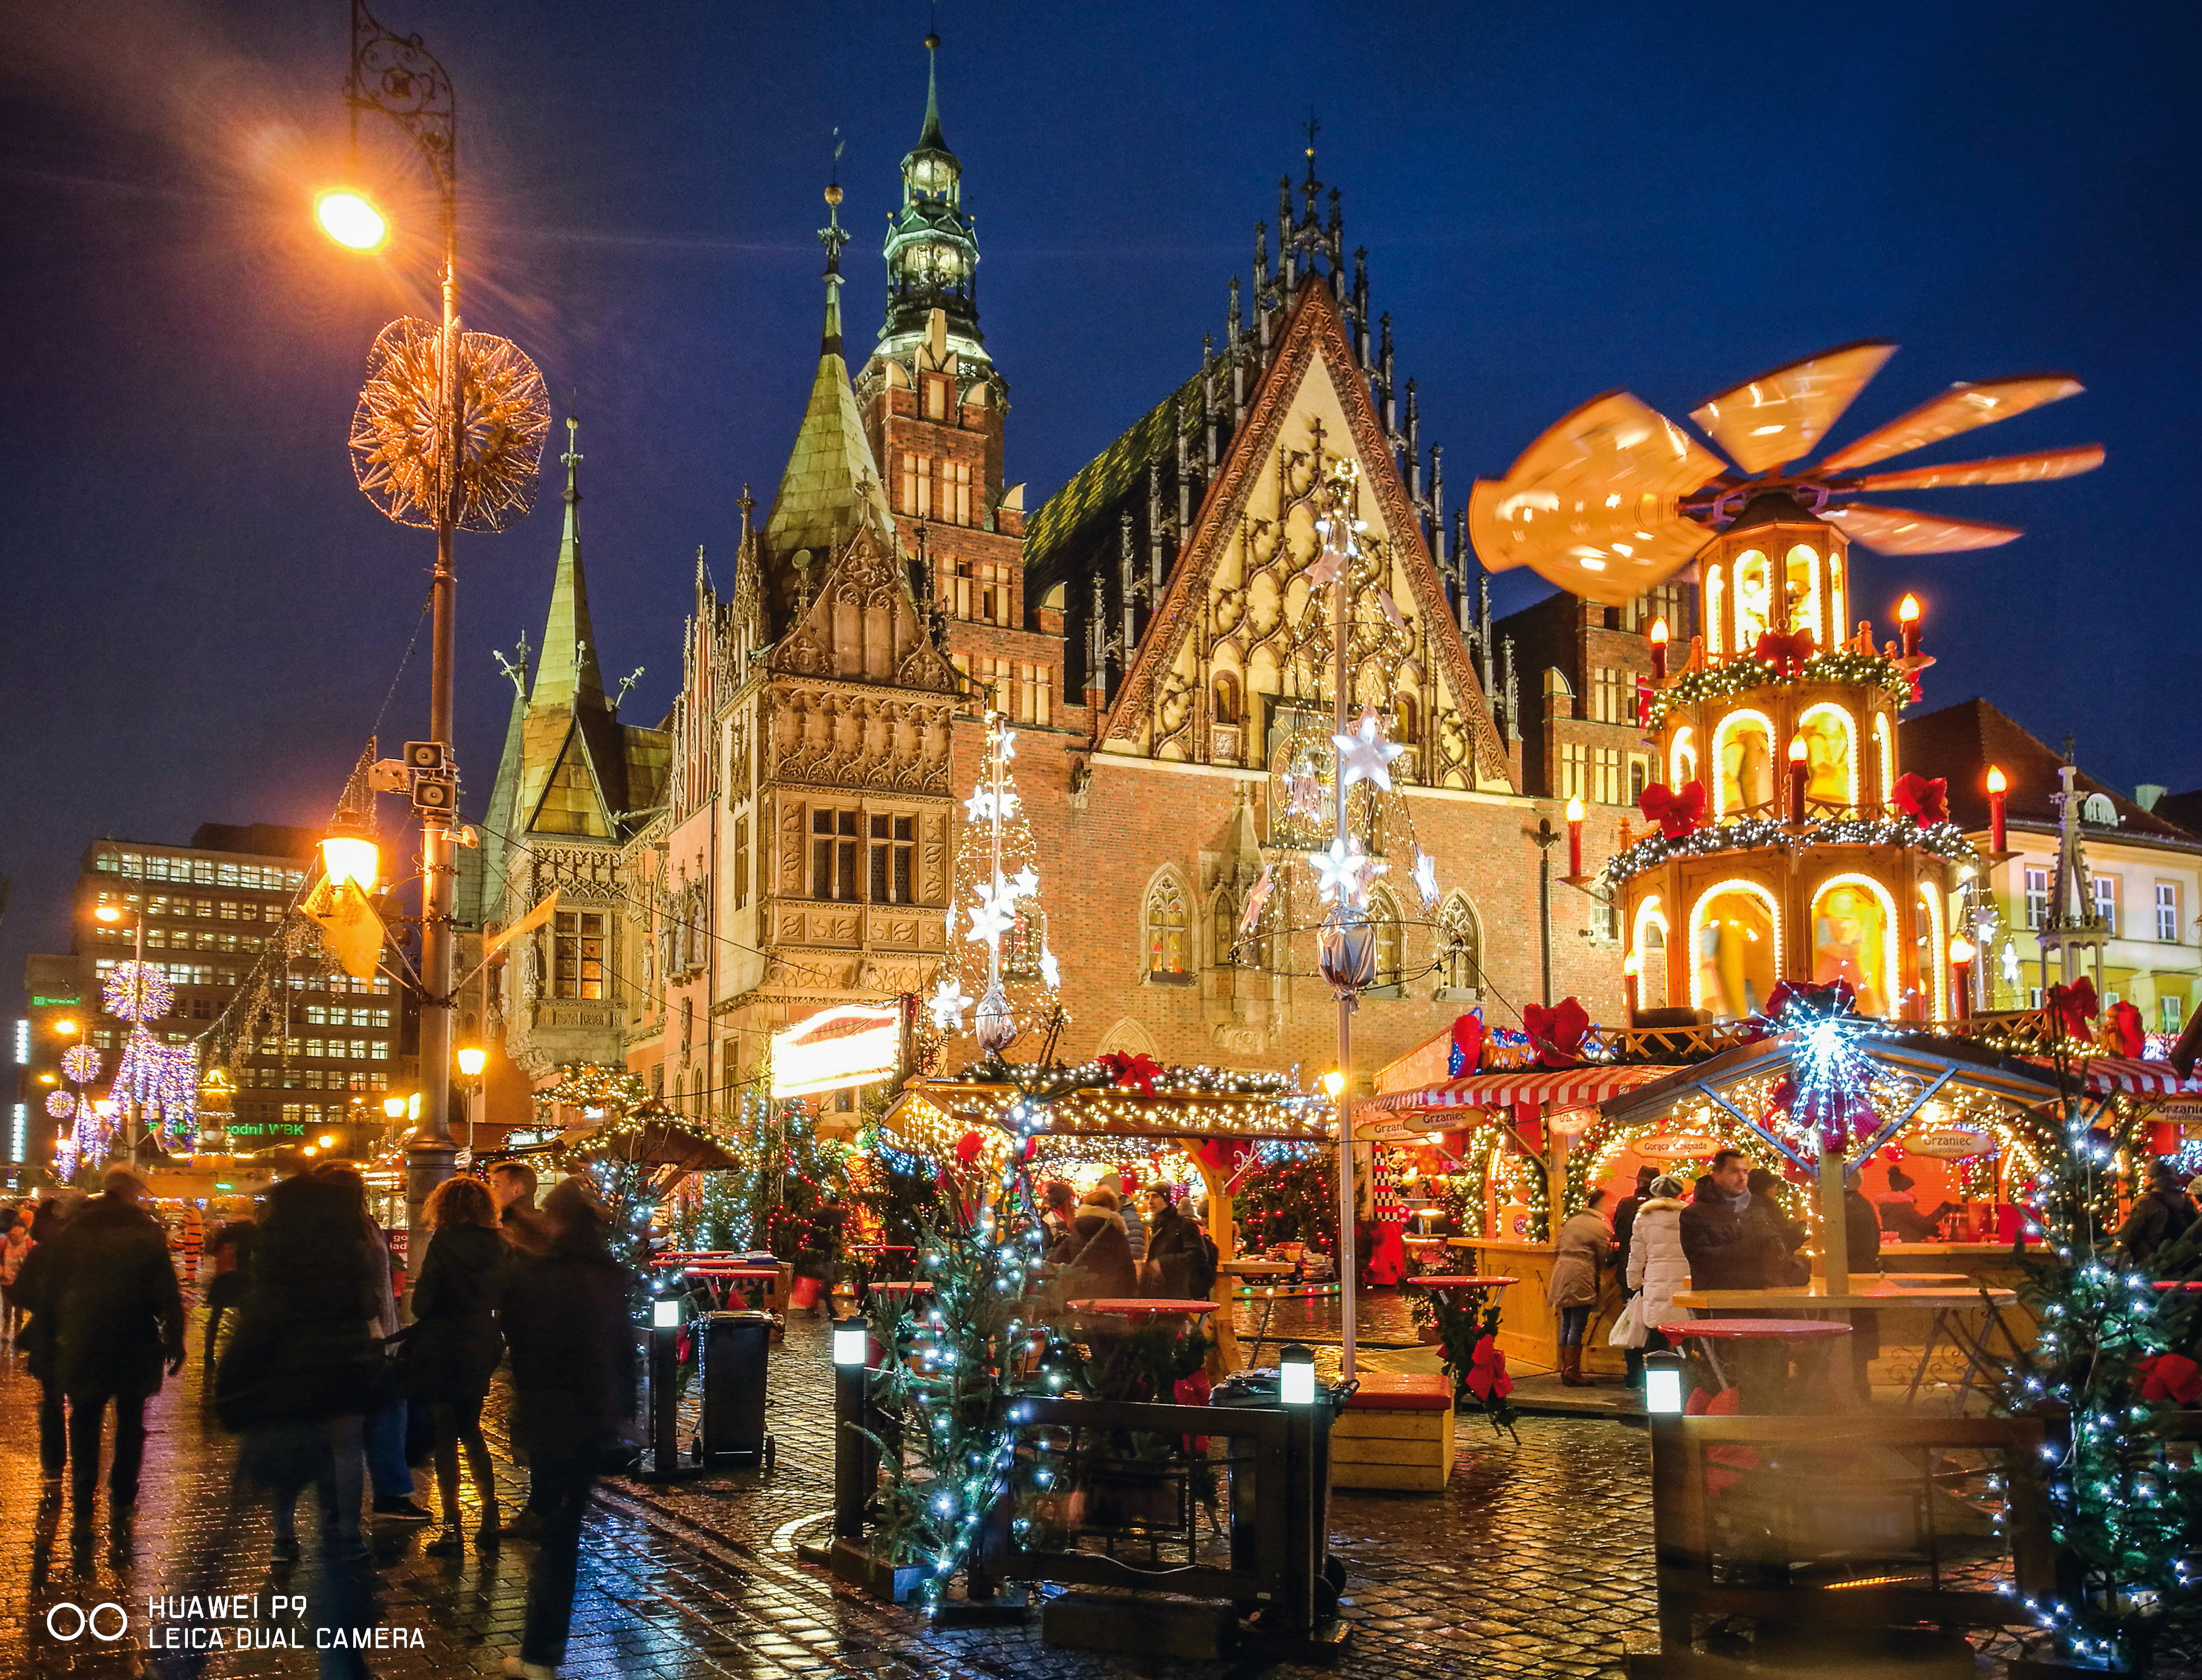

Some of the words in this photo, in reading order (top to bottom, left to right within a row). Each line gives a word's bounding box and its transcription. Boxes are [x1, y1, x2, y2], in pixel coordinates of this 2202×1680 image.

[1422, 1112, 1466, 1124] Grzaniec
[148, 1122, 187, 1134] Bnk
[1924, 1135, 1972, 1146] Grzaniec
[1644, 1142, 1669, 1151] Gorąca
